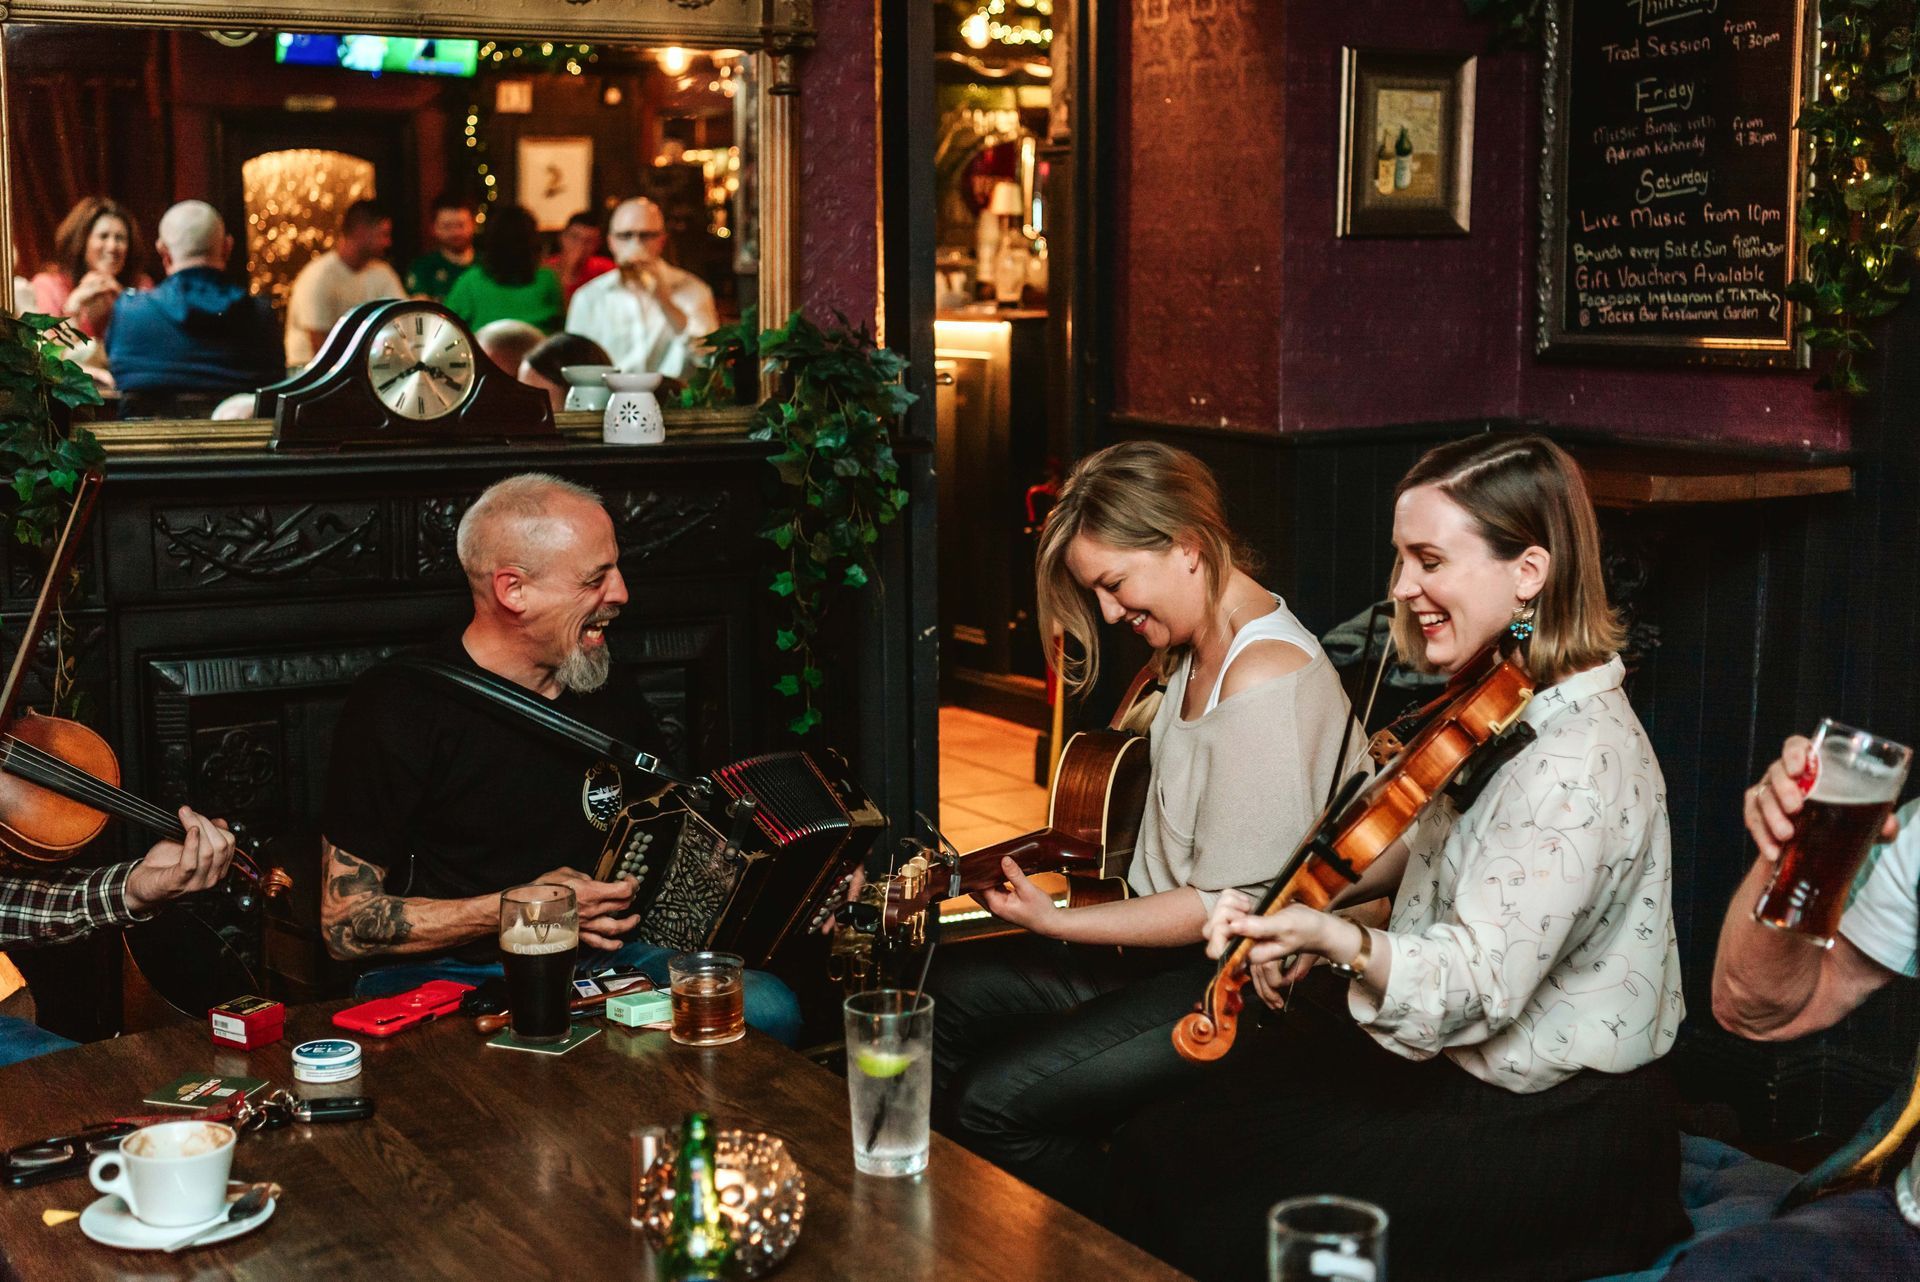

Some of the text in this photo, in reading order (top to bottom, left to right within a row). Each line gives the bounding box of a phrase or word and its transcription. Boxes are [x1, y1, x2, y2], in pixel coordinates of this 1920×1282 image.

[1723, 19, 1757, 34] from
[1602, 36, 1711, 63] Trad Session
[1687, 116, 1716, 130] with
[1733, 116, 1763, 130] from
[1606, 134, 1706, 165] Adrian Kennedy
[1581, 202, 1781, 232] Live Music from 10pm
[1573, 243, 1623, 264] Brunch
[1629, 246, 1660, 268] every
[1664, 239, 1690, 258] Sat
[1703, 239, 1727, 258] Sun
[1575, 263, 1765, 290] Gift Vouchers Available
[1648, 290, 1712, 312] Instagram
[1640, 303, 1658, 322] Bar
[1661, 305, 1719, 321] Restaurant
[1723, 305, 1759, 320] Garden
[513, 943, 568, 955] GUINNESS
[299, 1046, 354, 1054] VELO
